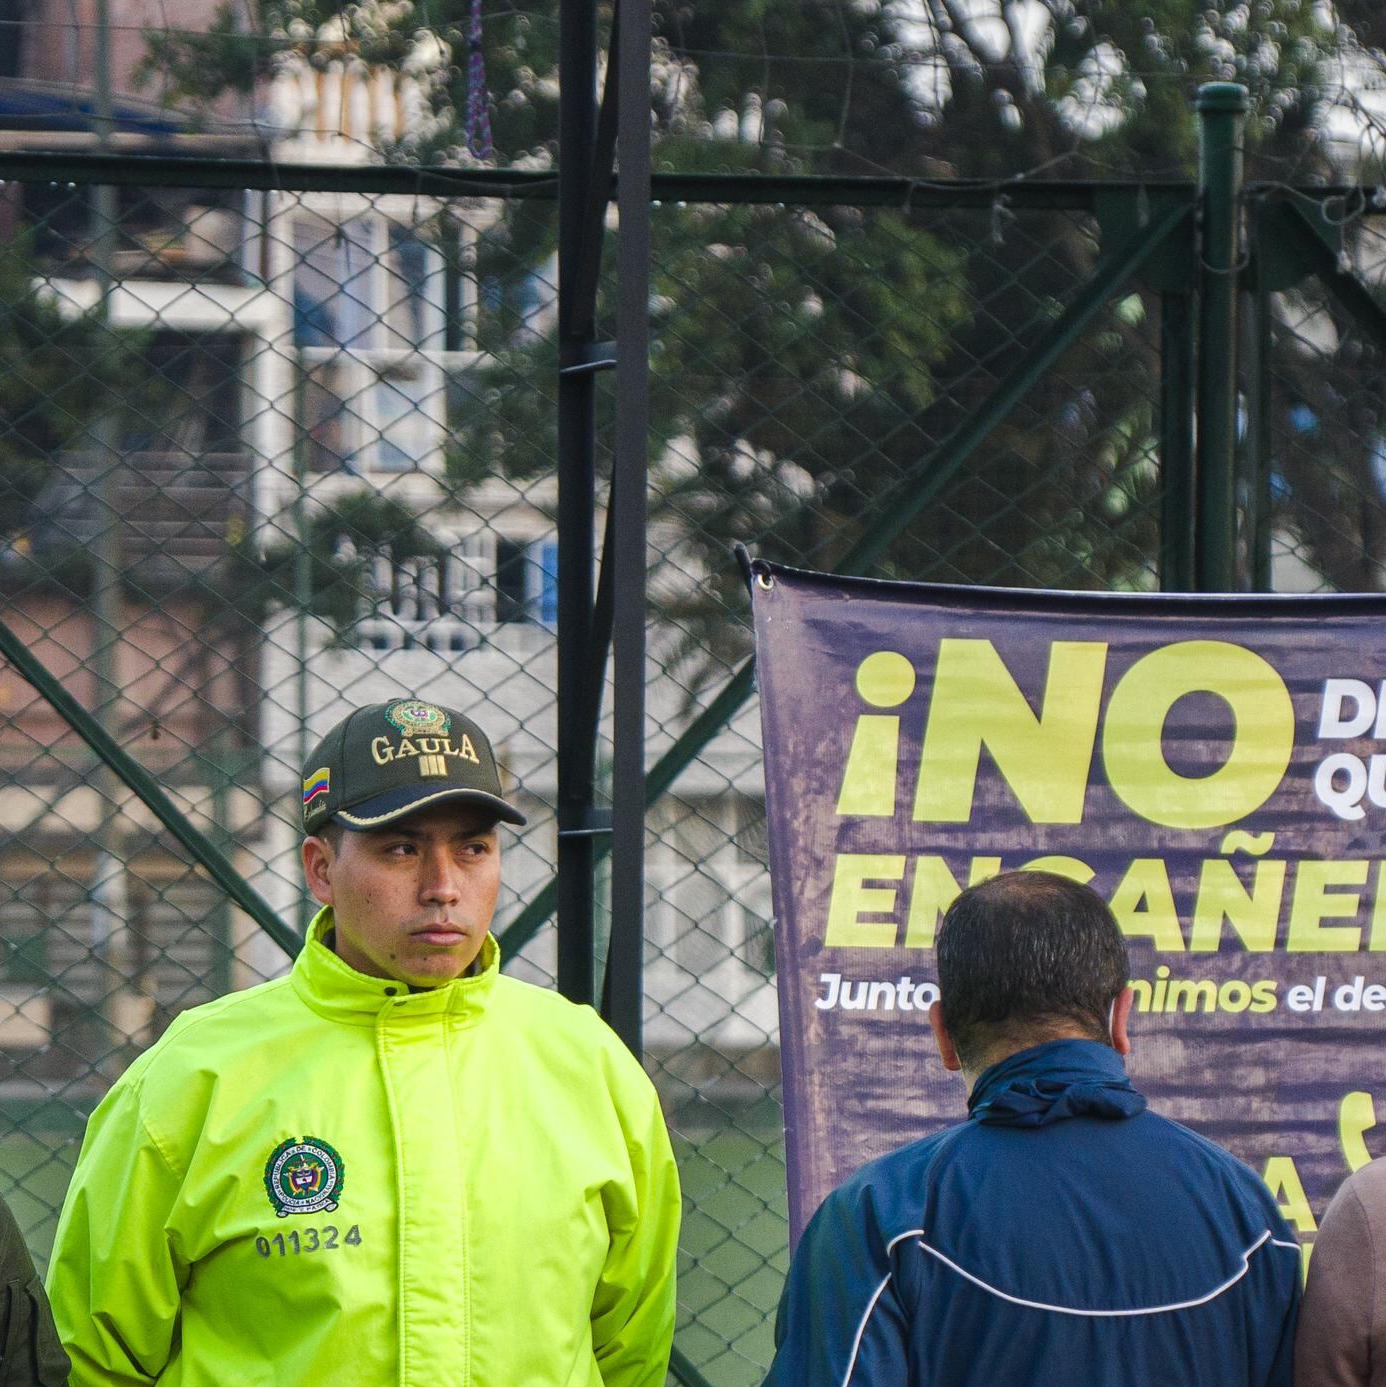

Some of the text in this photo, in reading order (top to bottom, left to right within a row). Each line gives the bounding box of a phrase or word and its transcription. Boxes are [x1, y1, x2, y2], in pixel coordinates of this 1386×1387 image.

[371, 733, 480, 766] GAULA
[835, 638, 1296, 829] ¡NO
[1287, 976, 1326, 1011] el
[256, 1224, 362, 1258] 011324
